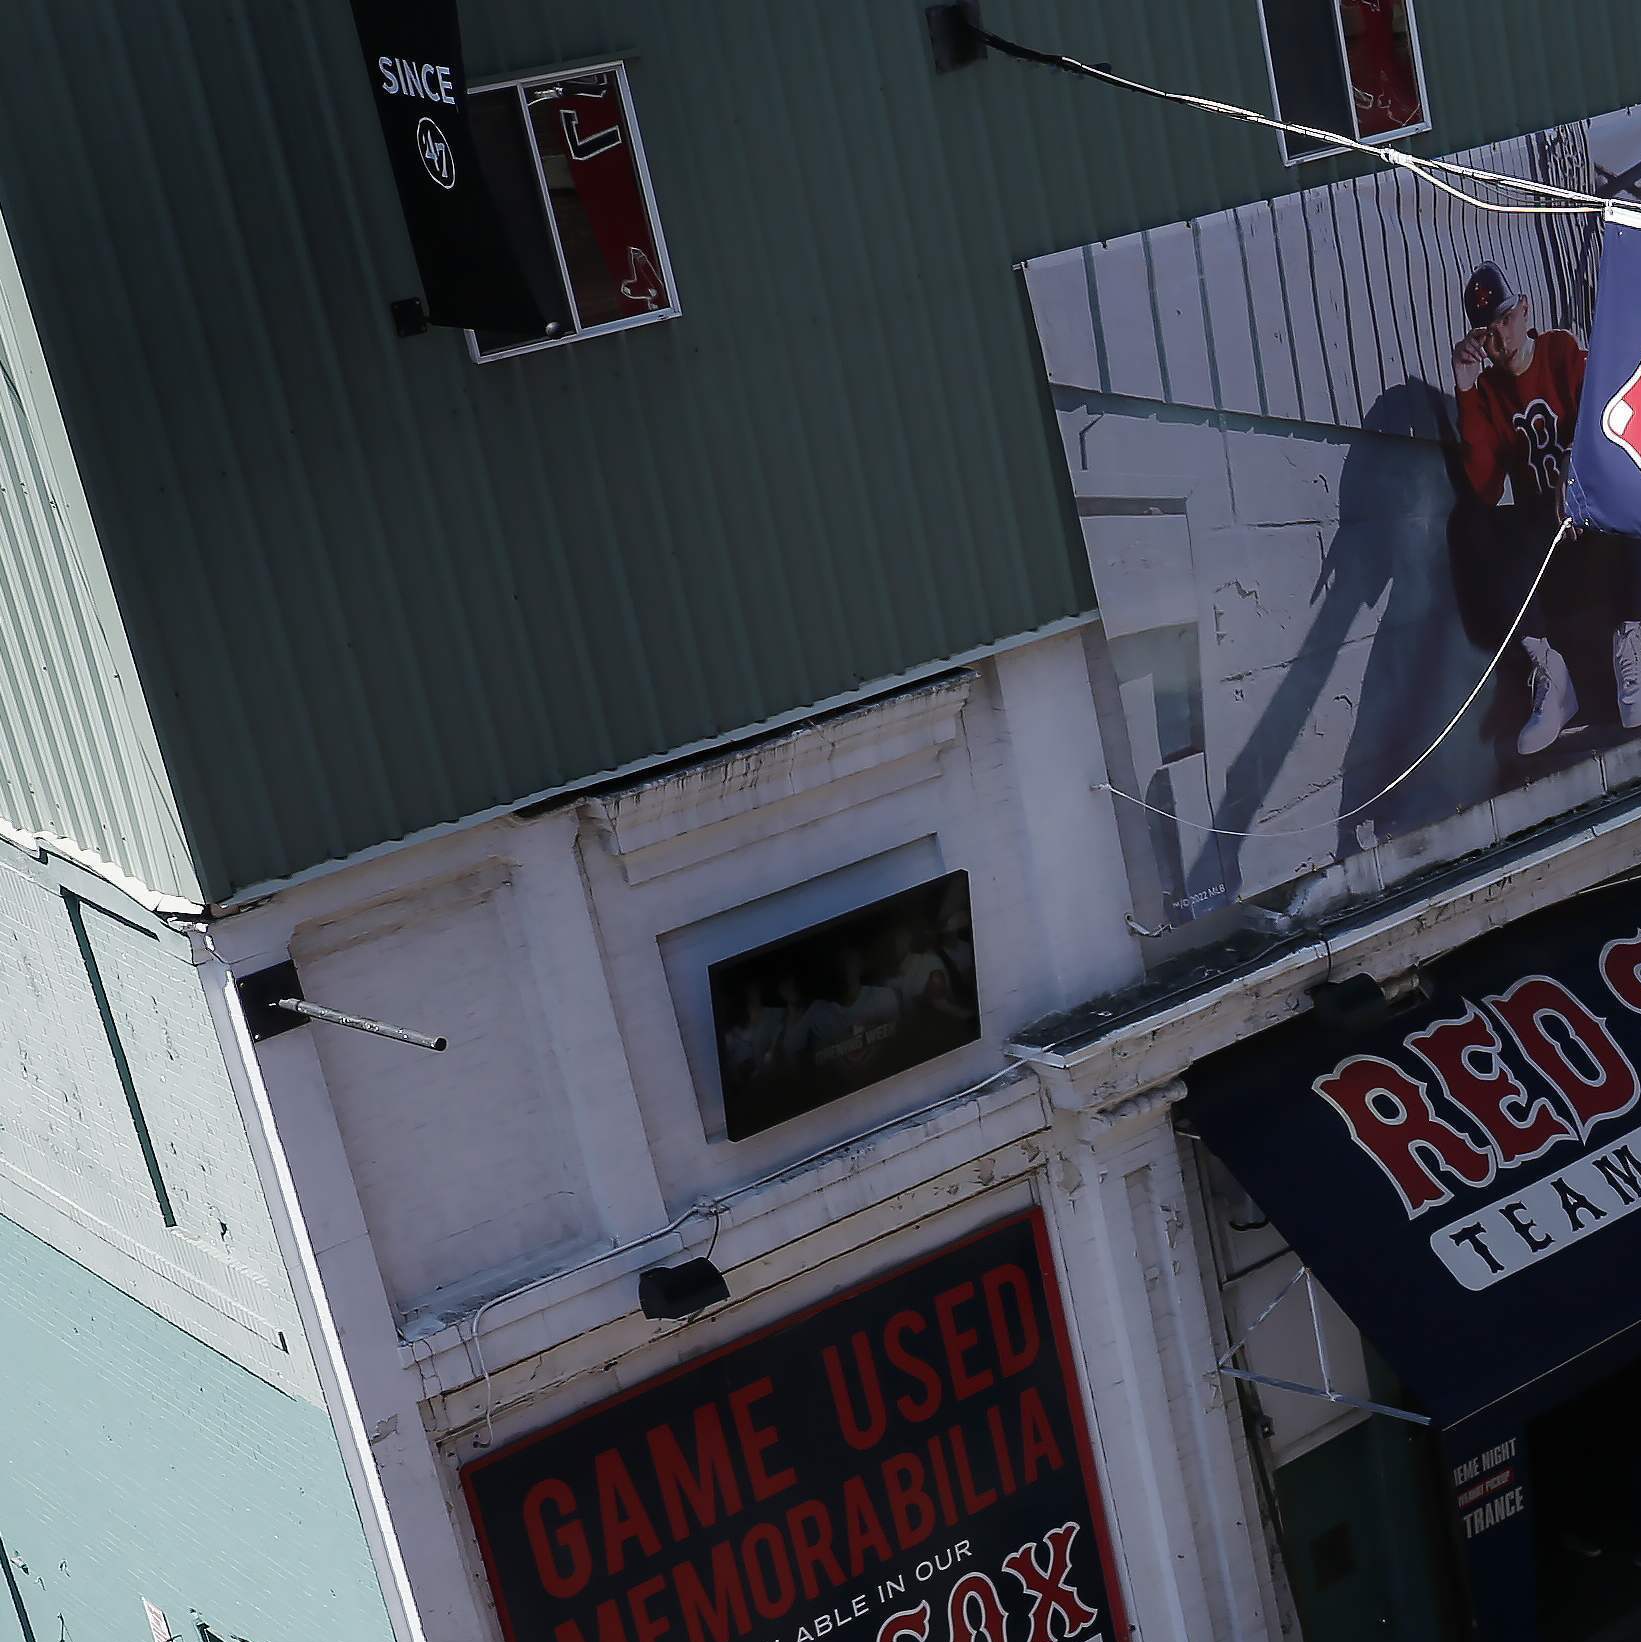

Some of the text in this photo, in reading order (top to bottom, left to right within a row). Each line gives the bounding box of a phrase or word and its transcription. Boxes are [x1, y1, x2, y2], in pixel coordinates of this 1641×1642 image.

[378, 56, 457, 105] SINCE
[521, 1260, 1042, 1602] GAME USED
[1481, 1436, 1518, 1473] NIGHT
[1462, 1486, 1526, 1540] TRANCE
[877, 1572, 909, 1602] IN
[916, 1537, 975, 1584] OUR
